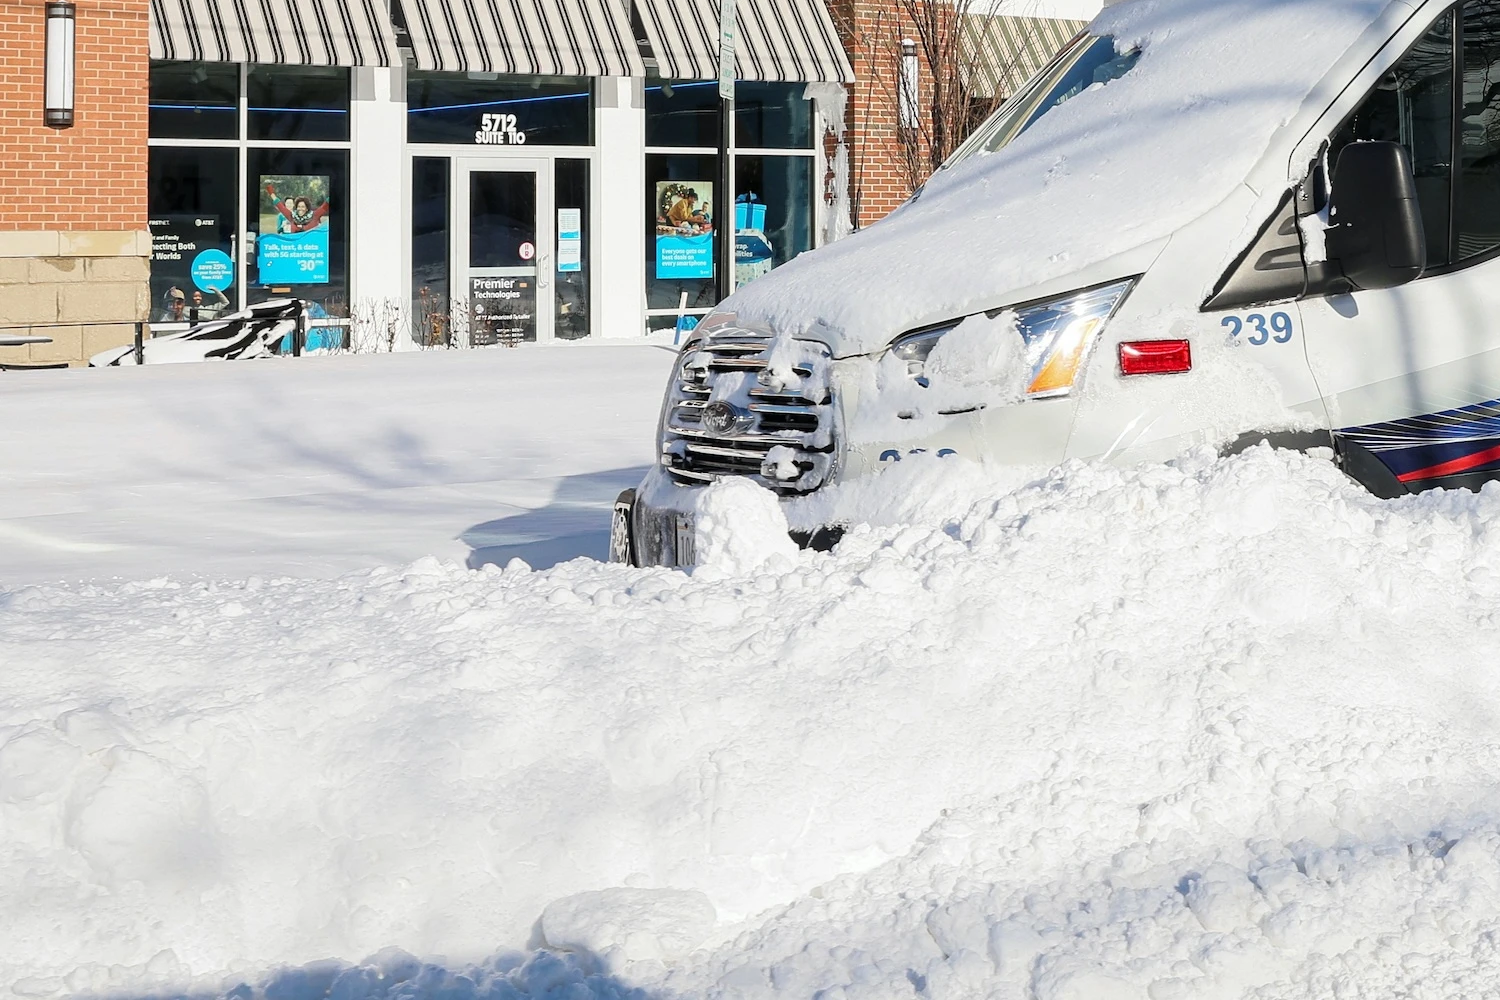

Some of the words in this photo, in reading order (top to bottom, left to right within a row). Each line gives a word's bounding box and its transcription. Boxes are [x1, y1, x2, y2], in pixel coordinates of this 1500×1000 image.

[481, 113, 517, 132] 5712
[475, 130, 504, 144] SUITE
[508, 131, 526, 145] 110
[152, 243, 177, 251] necting
[178, 242, 196, 250] Both
[156, 252, 182, 260] Worlds
[289, 251, 315, 259] starting
[661, 248, 685, 256] Everyone
[686, 248, 697, 256] gets
[473, 278, 515, 289] Premier
[473, 290, 521, 299] Technologies
[1221, 311, 1292, 347] 239
[704, 410, 728, 428] Ford
